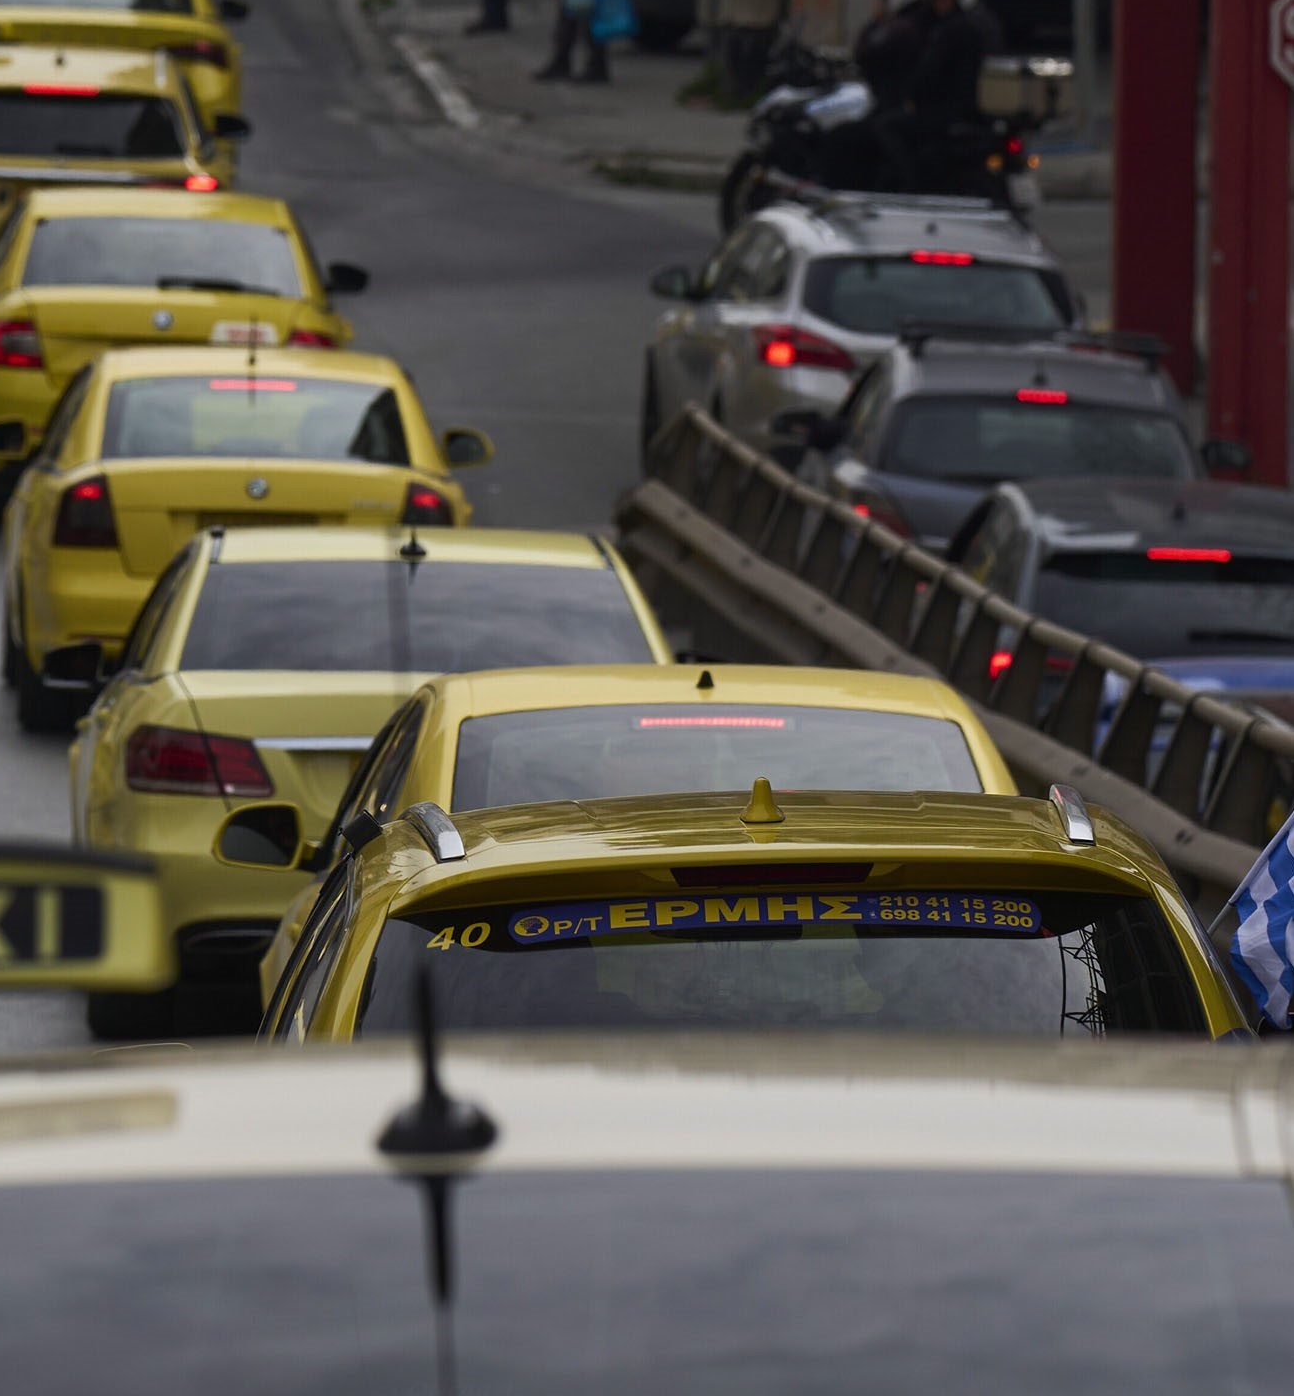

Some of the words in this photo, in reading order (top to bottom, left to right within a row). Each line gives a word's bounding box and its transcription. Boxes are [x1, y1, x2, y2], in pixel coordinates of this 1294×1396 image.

[609, 895, 863, 930] ΕΡΜΗΣ
[879, 895, 919, 907] 210
[926, 896, 950, 908] 41
[960, 898, 985, 910] 15
[992, 900, 1032, 914] 200
[880, 909, 921, 921] 698
[927, 910, 951, 922] 41
[961, 911, 987, 924] 15
[994, 913, 1034, 929] 200
[426, 922, 491, 951] 40
